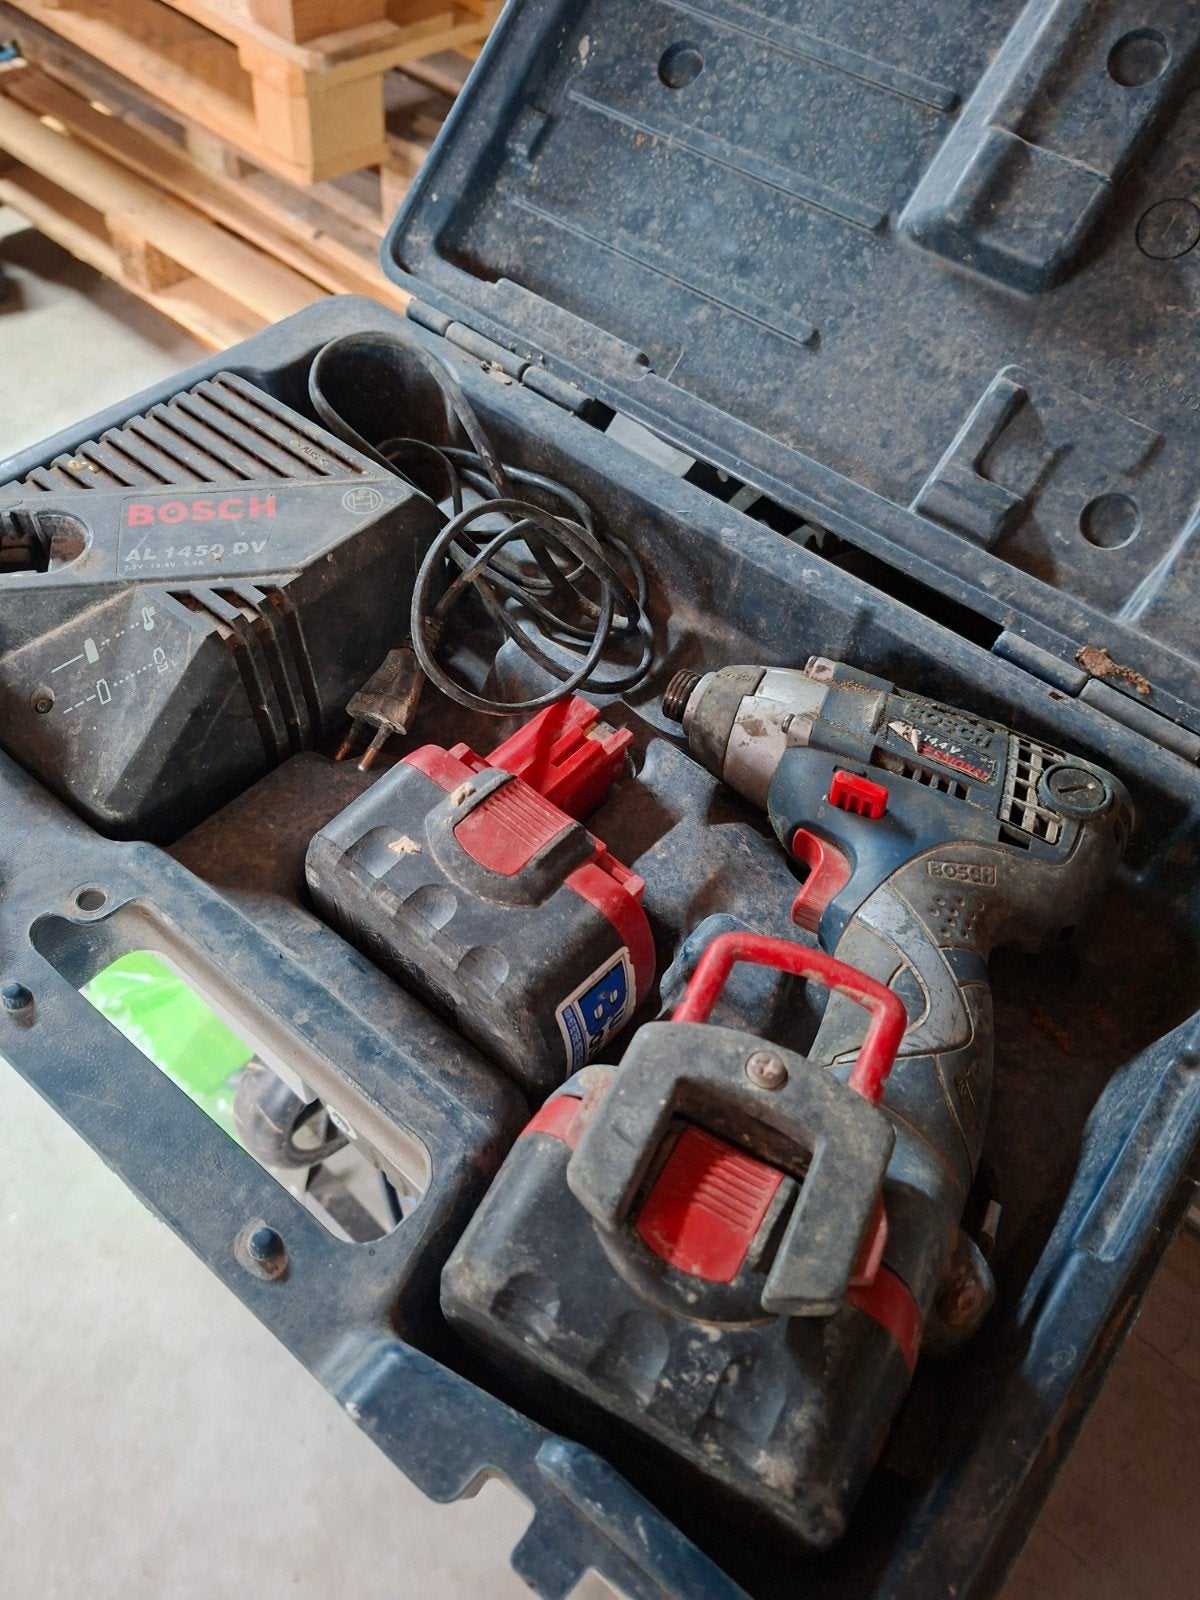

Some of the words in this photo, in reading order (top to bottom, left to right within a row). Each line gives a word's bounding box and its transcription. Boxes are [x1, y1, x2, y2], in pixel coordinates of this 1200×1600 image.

[127, 496, 277, 527] BOSCH
[125, 548, 157, 562] AL
[165, 543, 225, 561] 1450
[230, 541, 267, 558] DV
[903, 703, 993, 748] BOSCH
[927, 860, 996, 888] BOSCH
